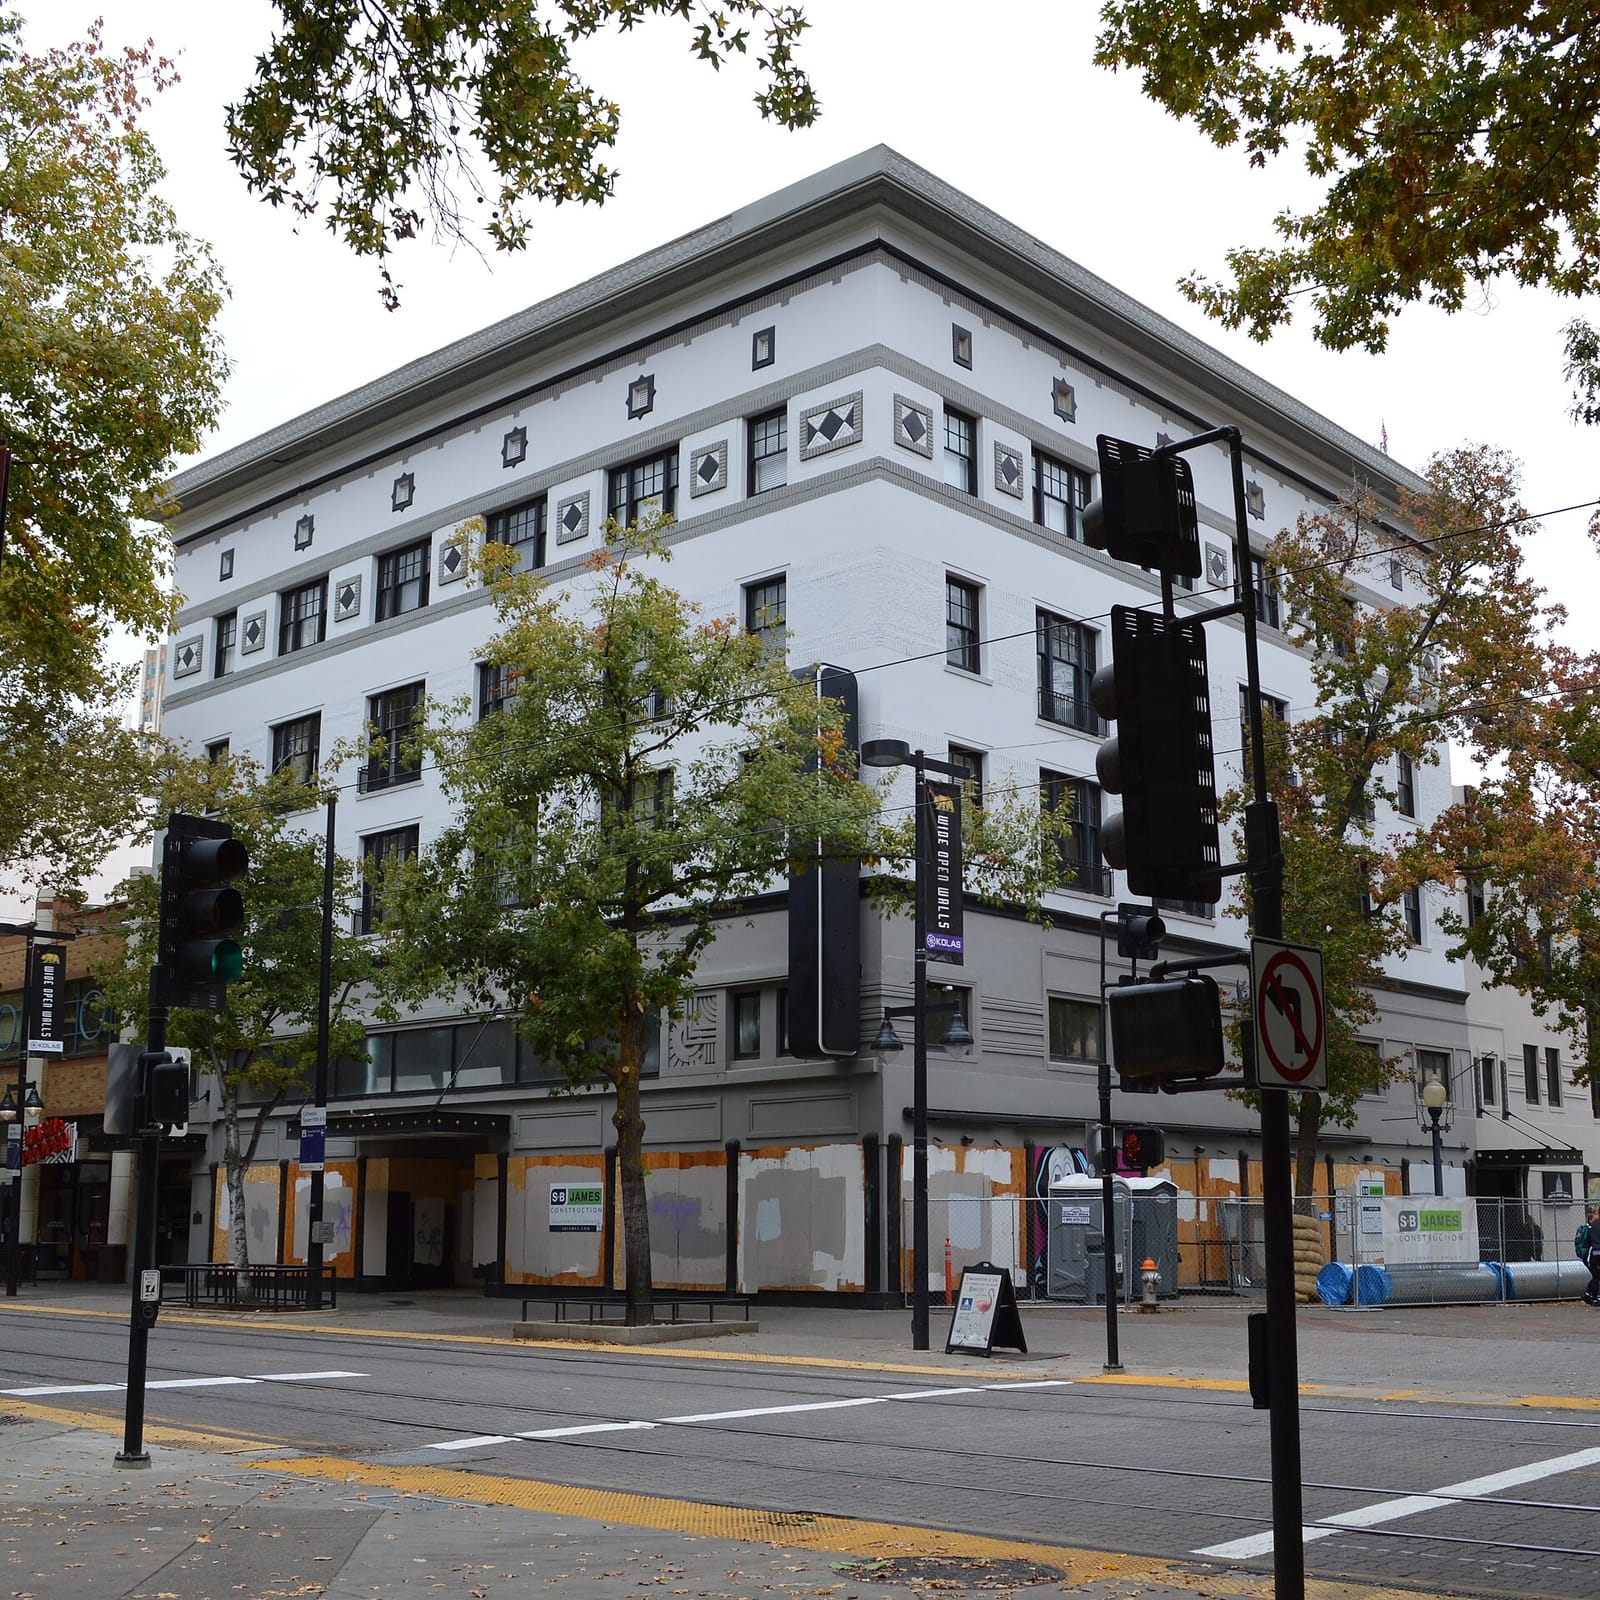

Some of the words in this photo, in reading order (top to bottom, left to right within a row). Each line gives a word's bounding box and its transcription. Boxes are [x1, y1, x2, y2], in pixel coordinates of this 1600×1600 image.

[937, 814, 949, 846] WIDE
[937, 850, 950, 882] OPEN
[937, 886, 950, 929] WALLS
[936, 938, 961, 949] KOLAS
[43, 965, 55, 985] WIDE
[42, 988, 54, 1008] OPEN
[41, 1010, 53, 1038] WALLS
[38, 1041, 61, 1050] KOLAS
[569, 1191, 601, 1202] JAMES
[1422, 1215, 1460, 1227] JAMES
[1399, 1234, 1464, 1242] CONSTRUCTION
